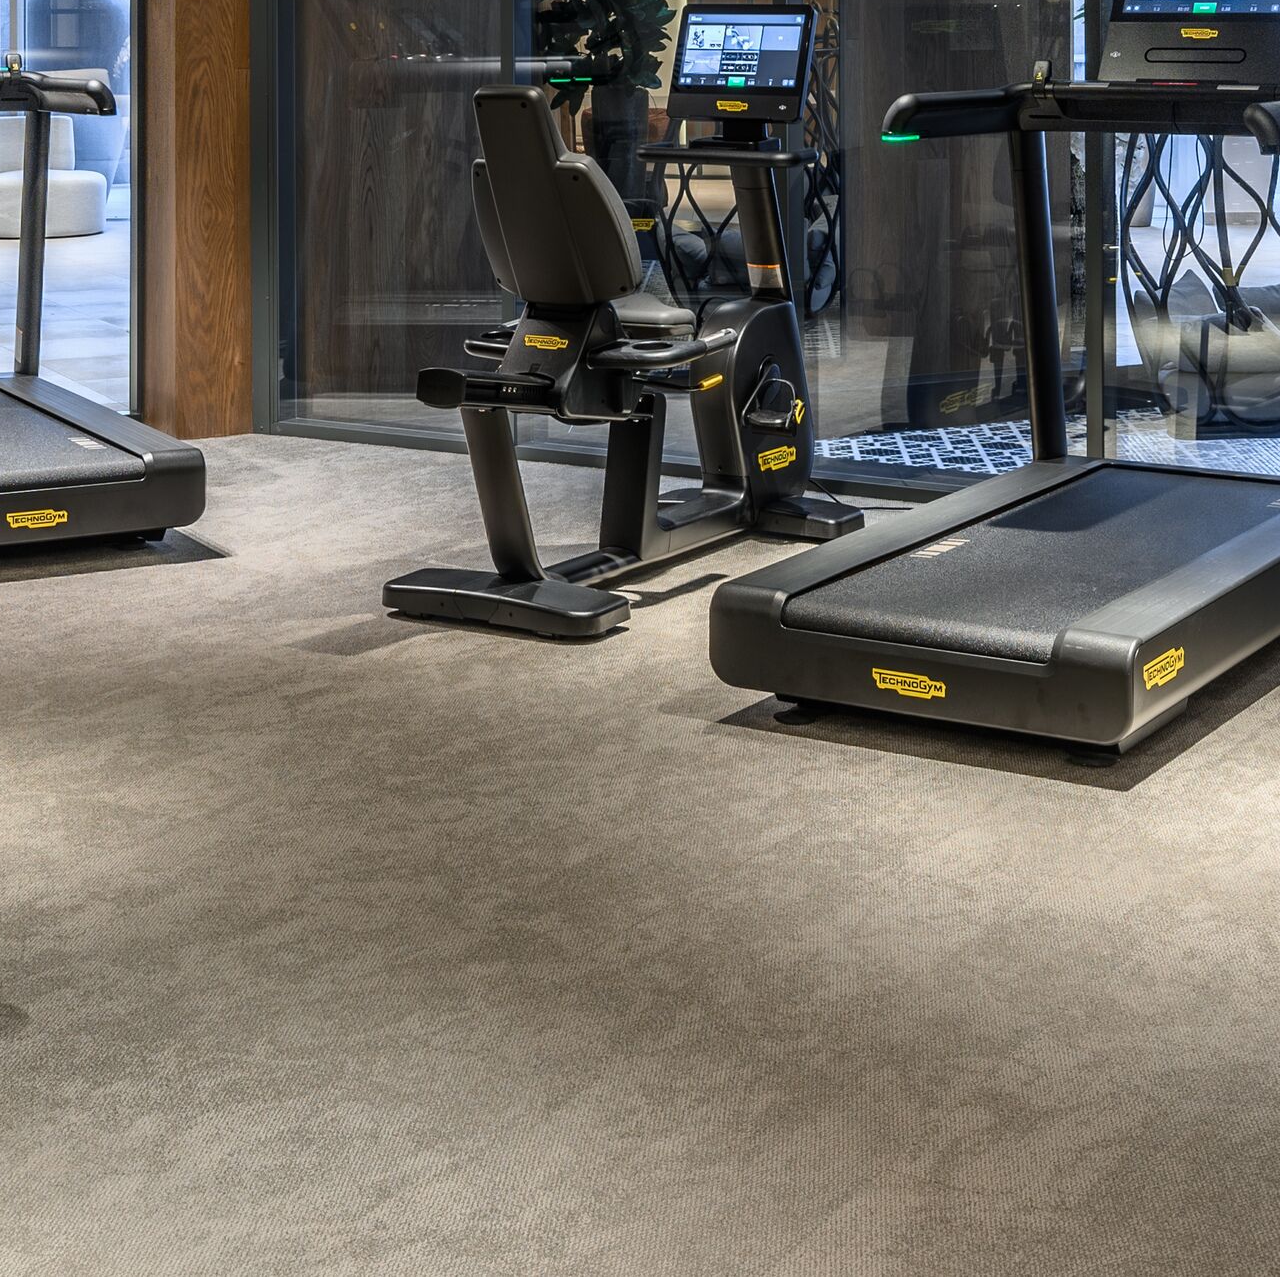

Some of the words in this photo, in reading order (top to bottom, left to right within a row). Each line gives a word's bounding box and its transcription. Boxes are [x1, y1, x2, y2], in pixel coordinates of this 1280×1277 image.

[8, 511, 66, 526] TECHNOGYM
[1144, 651, 1183, 684] TECHNOGYM
[873, 670, 944, 695] TECHNOGYM
